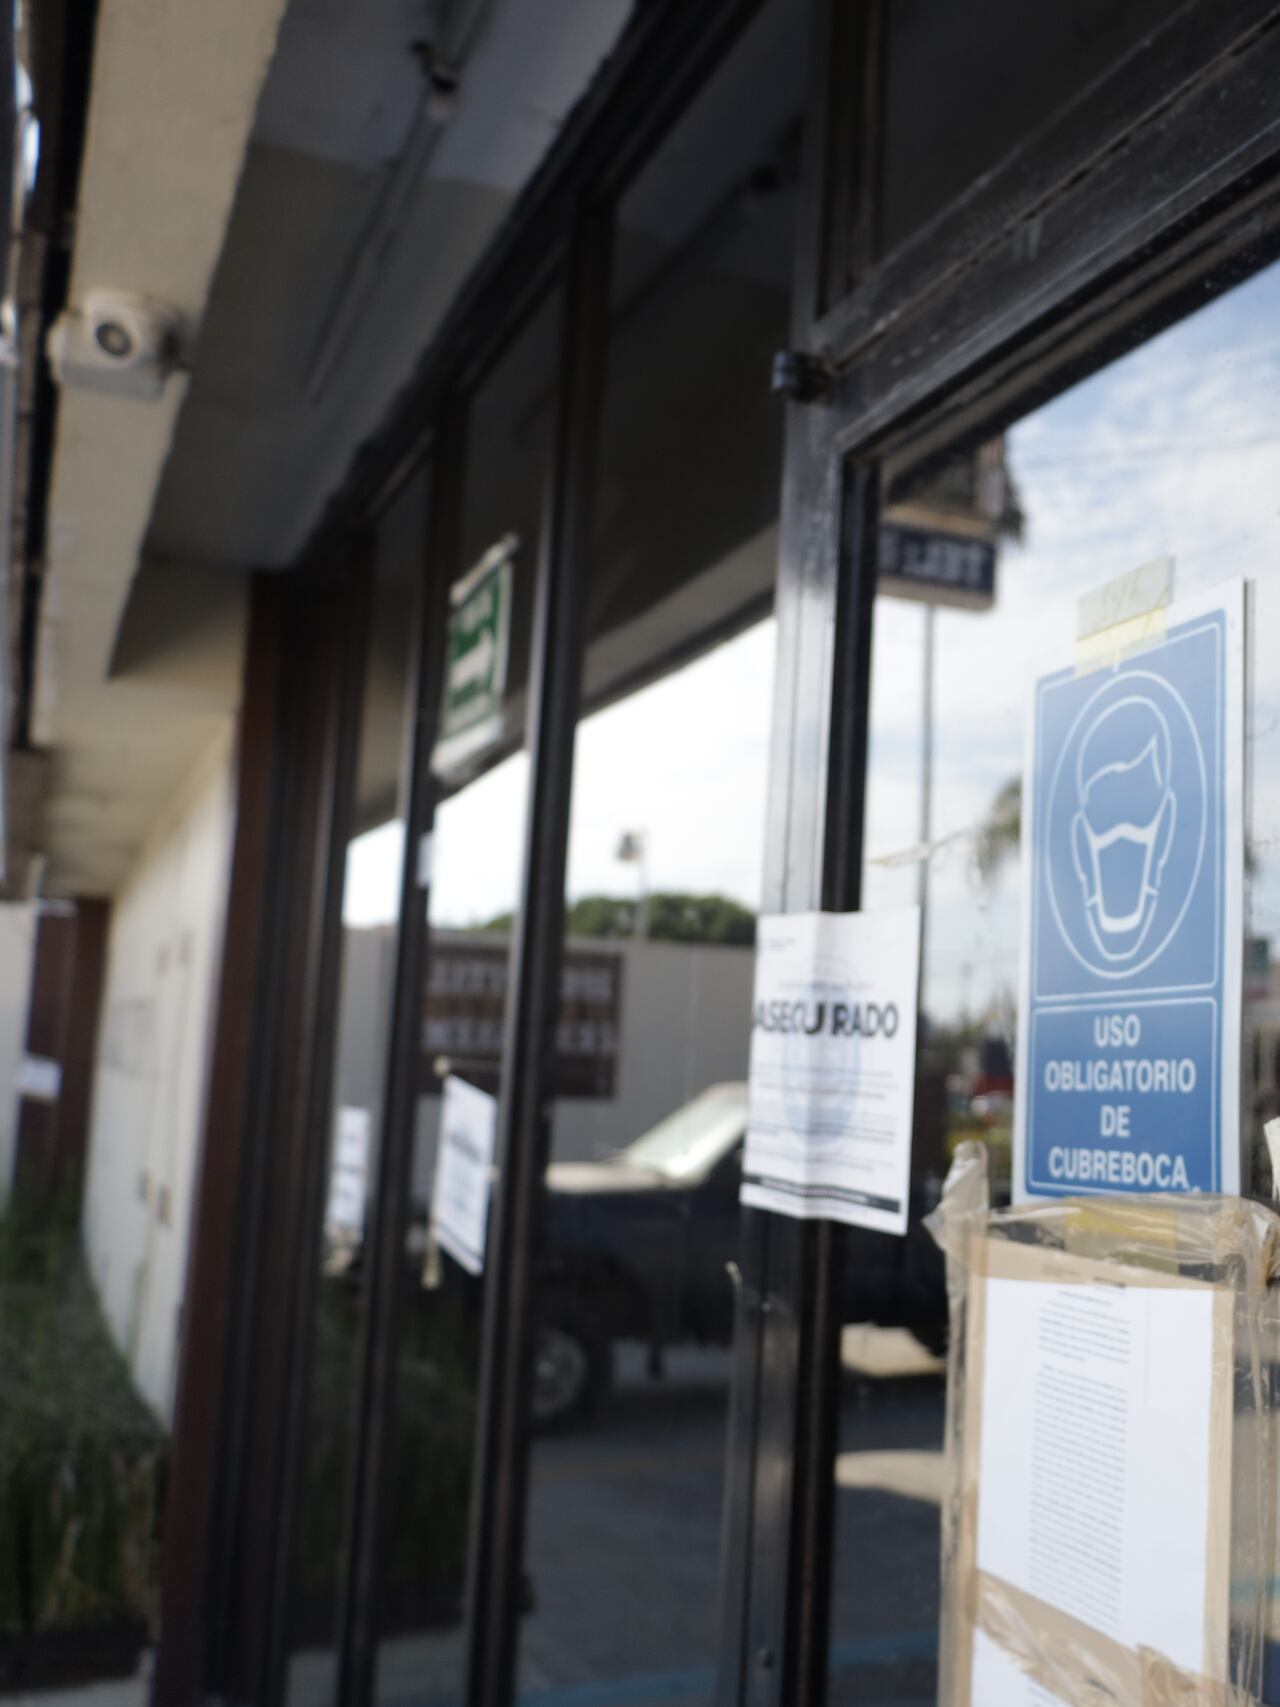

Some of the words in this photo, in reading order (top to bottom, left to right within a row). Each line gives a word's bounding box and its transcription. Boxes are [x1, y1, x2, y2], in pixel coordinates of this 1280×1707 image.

[1093, 1014, 1142, 1048] USO
[1044, 1058, 1197, 1094] OBLIGATORIO
[1100, 1105, 1131, 1138] DE
[1048, 1145, 1190, 1190] CUBREBOCA
